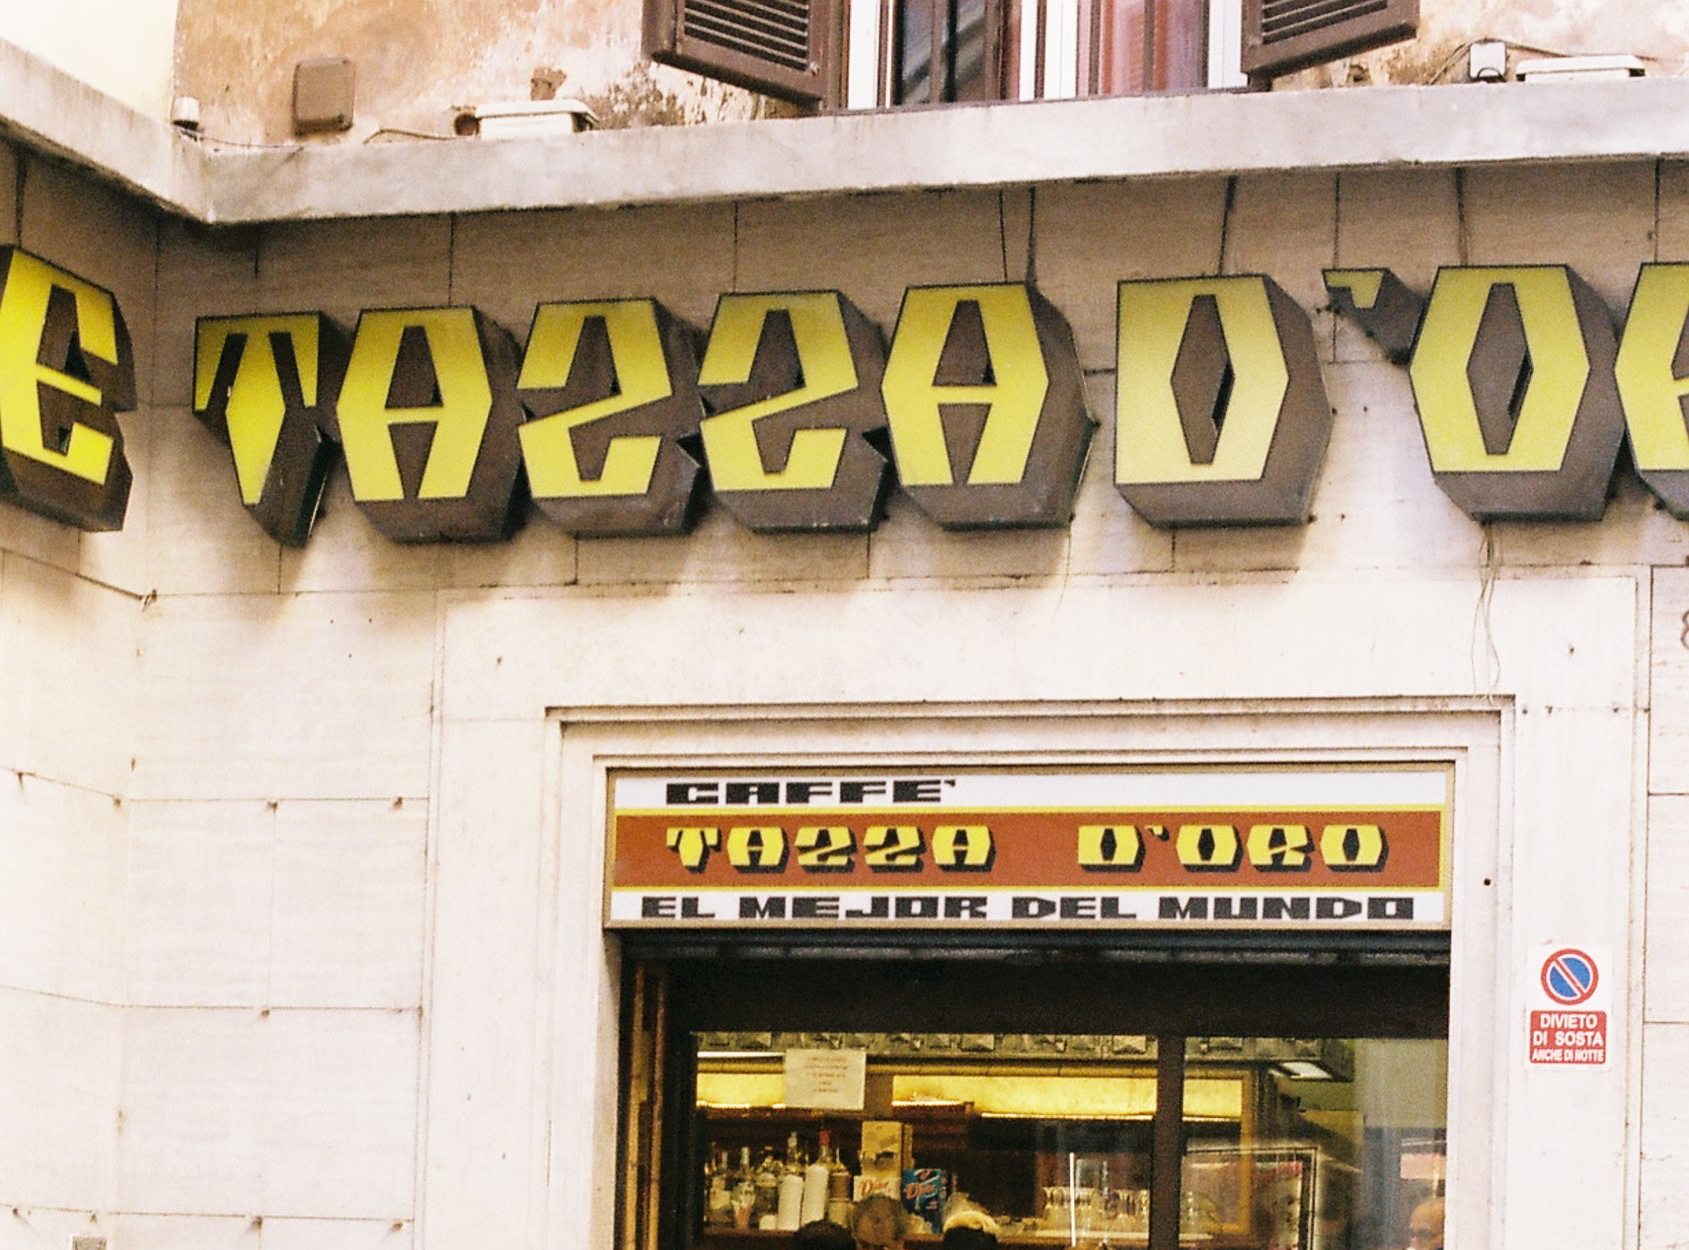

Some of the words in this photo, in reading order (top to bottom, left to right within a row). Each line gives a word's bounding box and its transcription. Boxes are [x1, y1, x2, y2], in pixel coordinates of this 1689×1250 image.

[194, 282, 1051, 506] TAZZA
[666, 825, 996, 873] TAZZA
[1078, 824, 1389, 873] D'ORO
[641, 896, 716, 919] EL
[738, 896, 988, 919] MEJOR
[1012, 896, 1137, 919] DEL
[1158, 896, 1415, 920] MUNDO
[1540, 1013, 1598, 1029] DIVIETO
[1532, 1030, 1548, 1047] DI
[1554, 1030, 1604, 1047] SOSTA
[1531, 1048, 1562, 1061] ANCHE
[1564, 1048, 1574, 1061] DI
[1575, 1049, 1605, 1062] NOTTE
